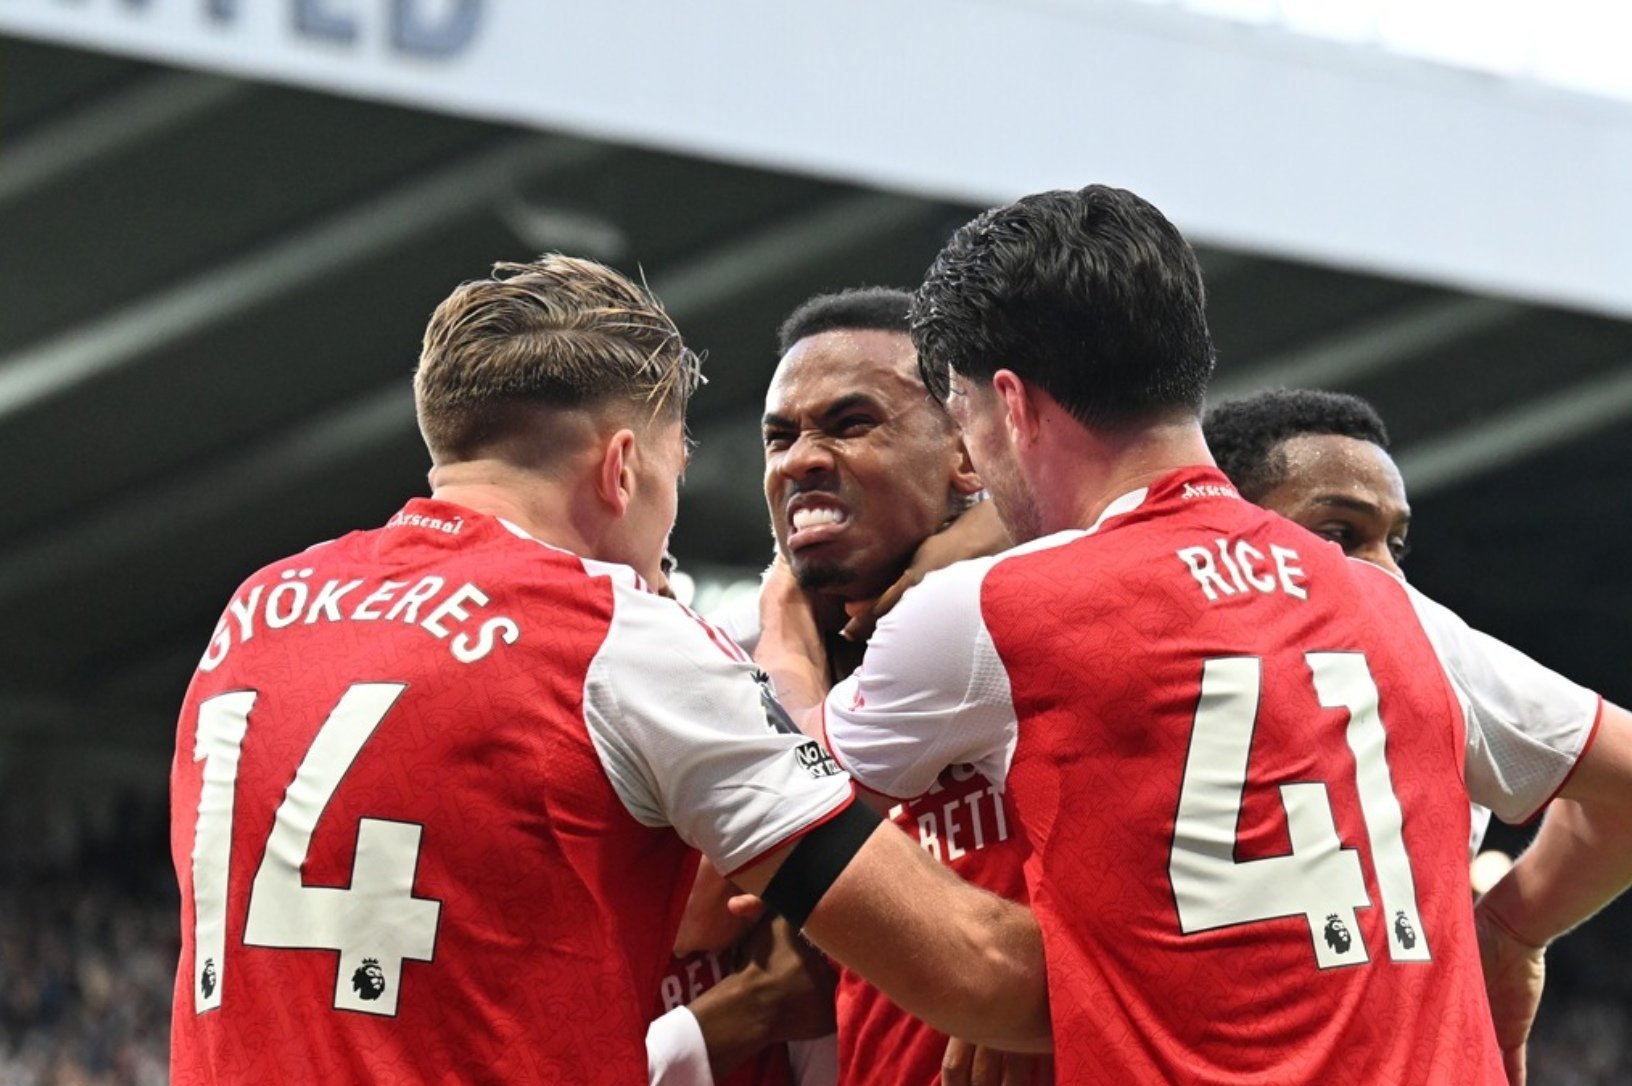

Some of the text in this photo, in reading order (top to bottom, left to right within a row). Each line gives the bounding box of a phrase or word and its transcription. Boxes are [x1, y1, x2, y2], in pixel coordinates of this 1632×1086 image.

[386, 511, 464, 535] Arsenal
[1176, 538, 1309, 602] RICE
[197, 567, 520, 672] GYÖKERES
[191, 681, 443, 1018] 14
[918, 785, 1008, 864] BETT
[1168, 651, 1433, 971] 41
